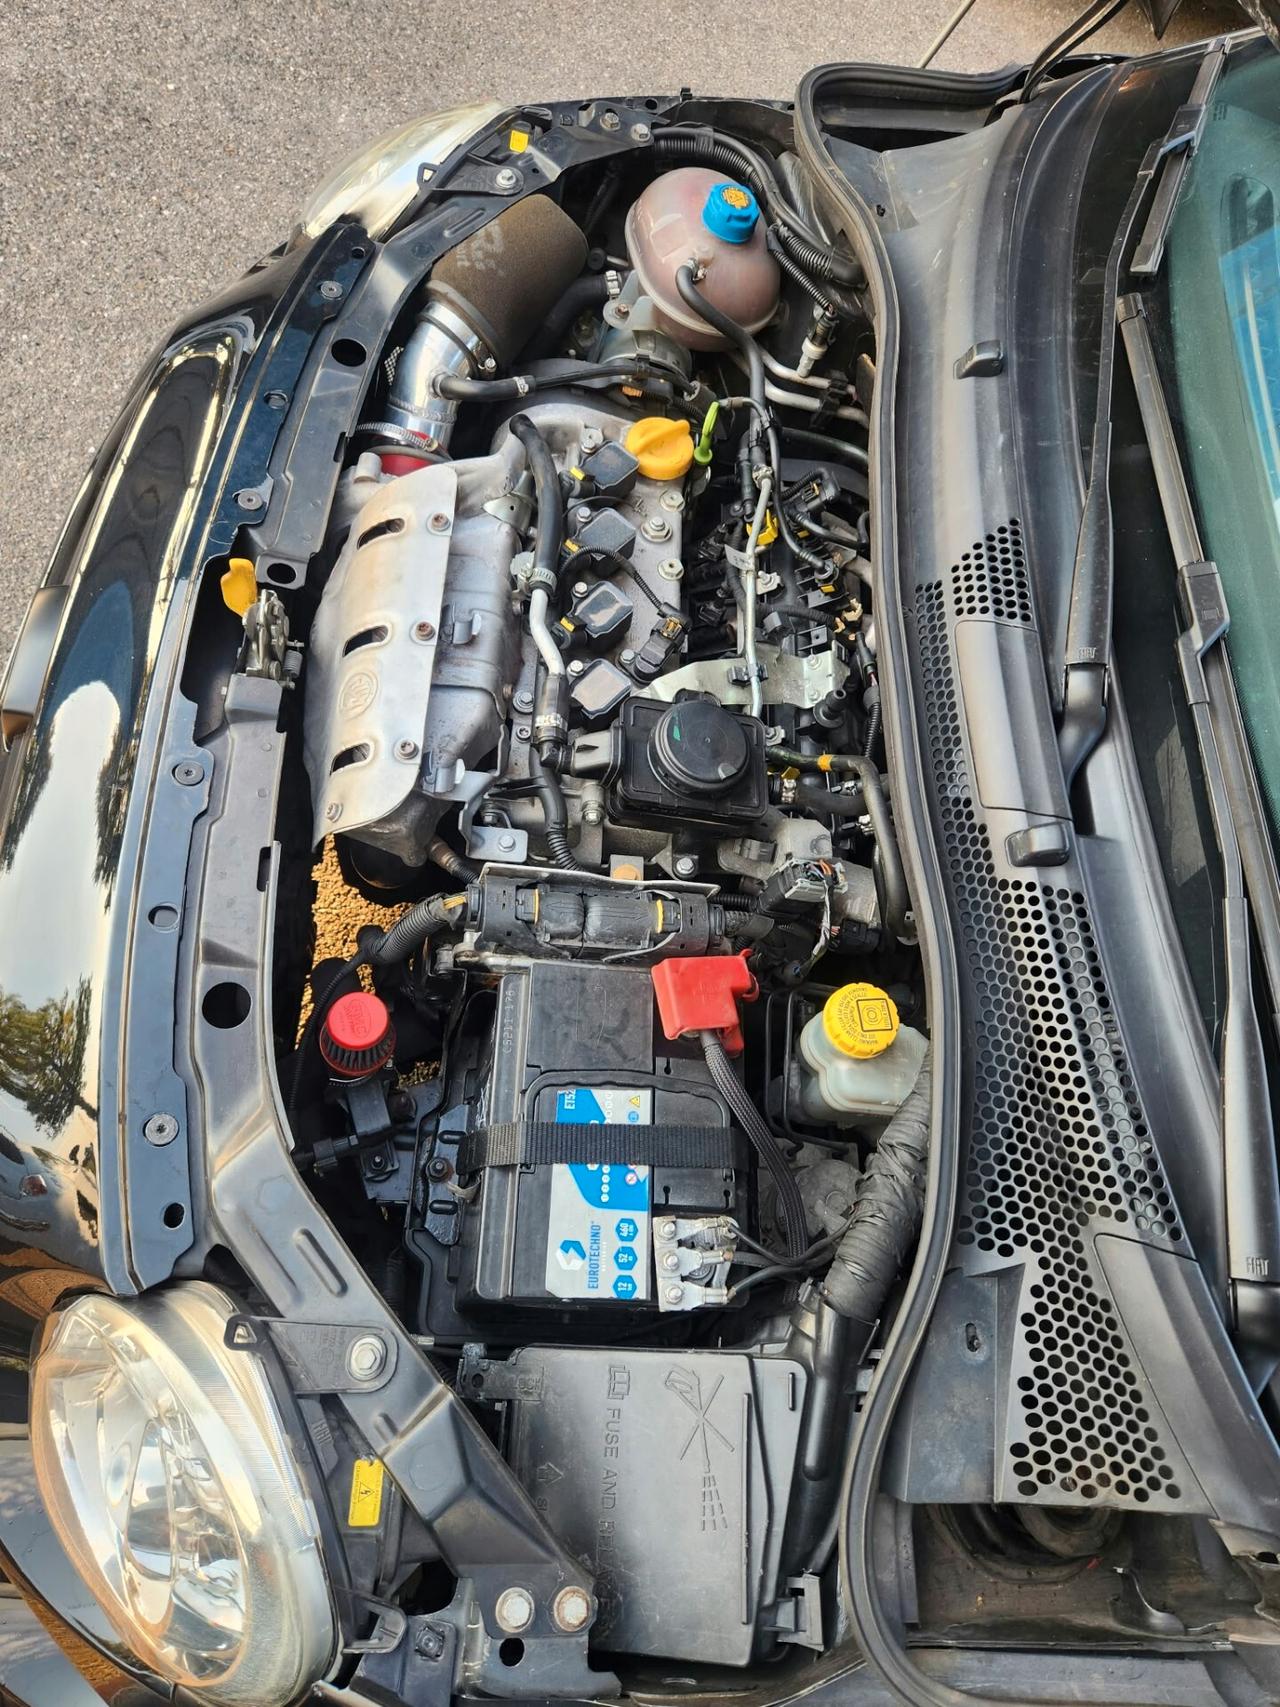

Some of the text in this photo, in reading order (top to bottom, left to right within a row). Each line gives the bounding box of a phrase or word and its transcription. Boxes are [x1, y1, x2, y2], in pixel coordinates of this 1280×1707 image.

[588, 1224, 601, 1289] EUROTECHNO
[618, 1253, 628, 1263] 52
[1246, 1256, 1270, 1277] FIAT
[617, 1282, 627, 1291] 12
[603, 1407, 621, 1458] FUSE
[600, 1469, 618, 1510] AND
